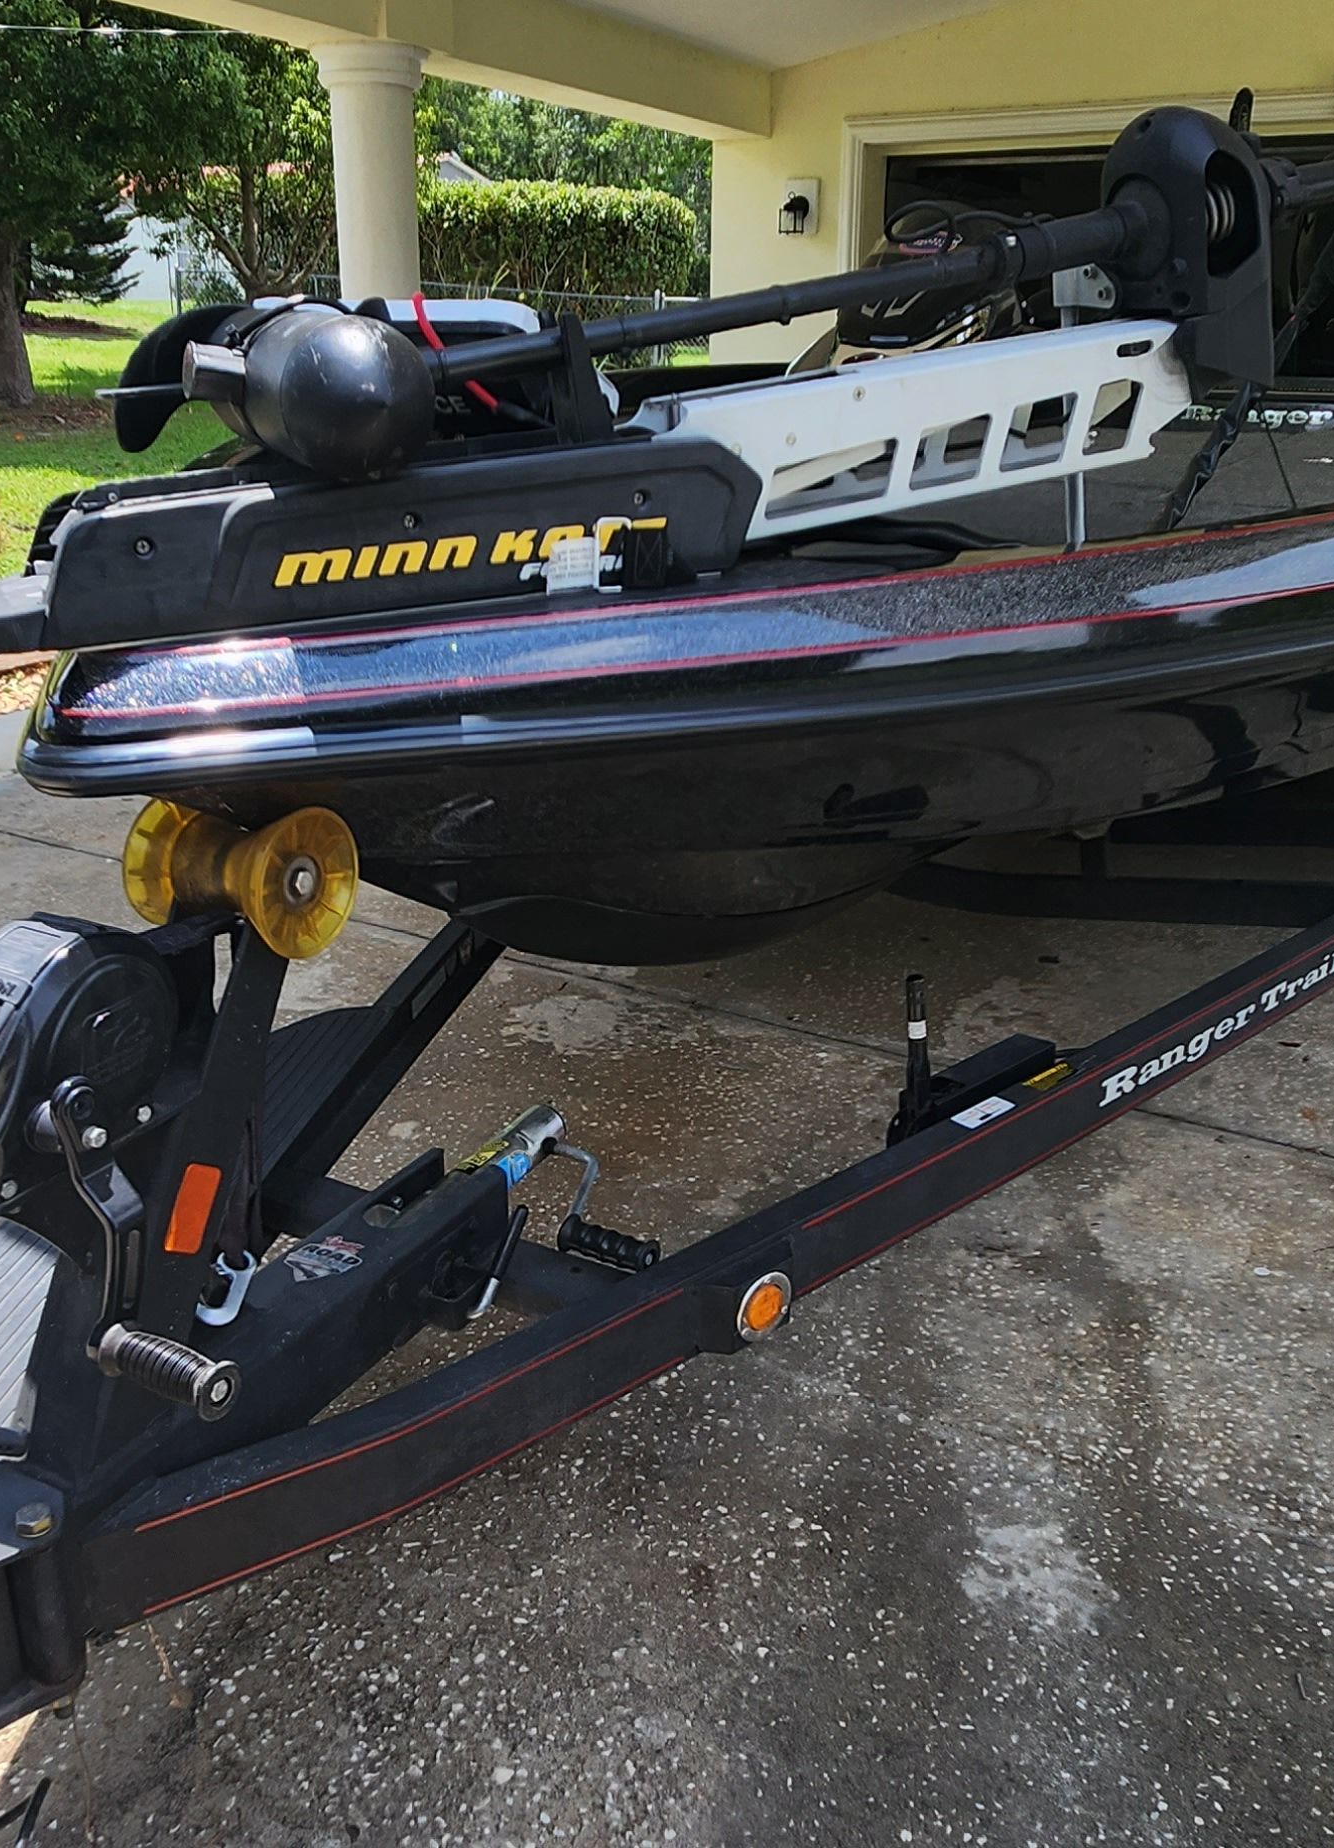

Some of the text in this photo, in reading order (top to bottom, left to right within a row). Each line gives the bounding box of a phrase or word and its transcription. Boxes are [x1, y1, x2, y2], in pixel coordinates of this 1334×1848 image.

[273, 535, 478, 588] MINN
[490, 515, 667, 565] KOT
[1099, 1002, 1257, 1107] Ranger
[302, 1244, 360, 1265] ROAD
